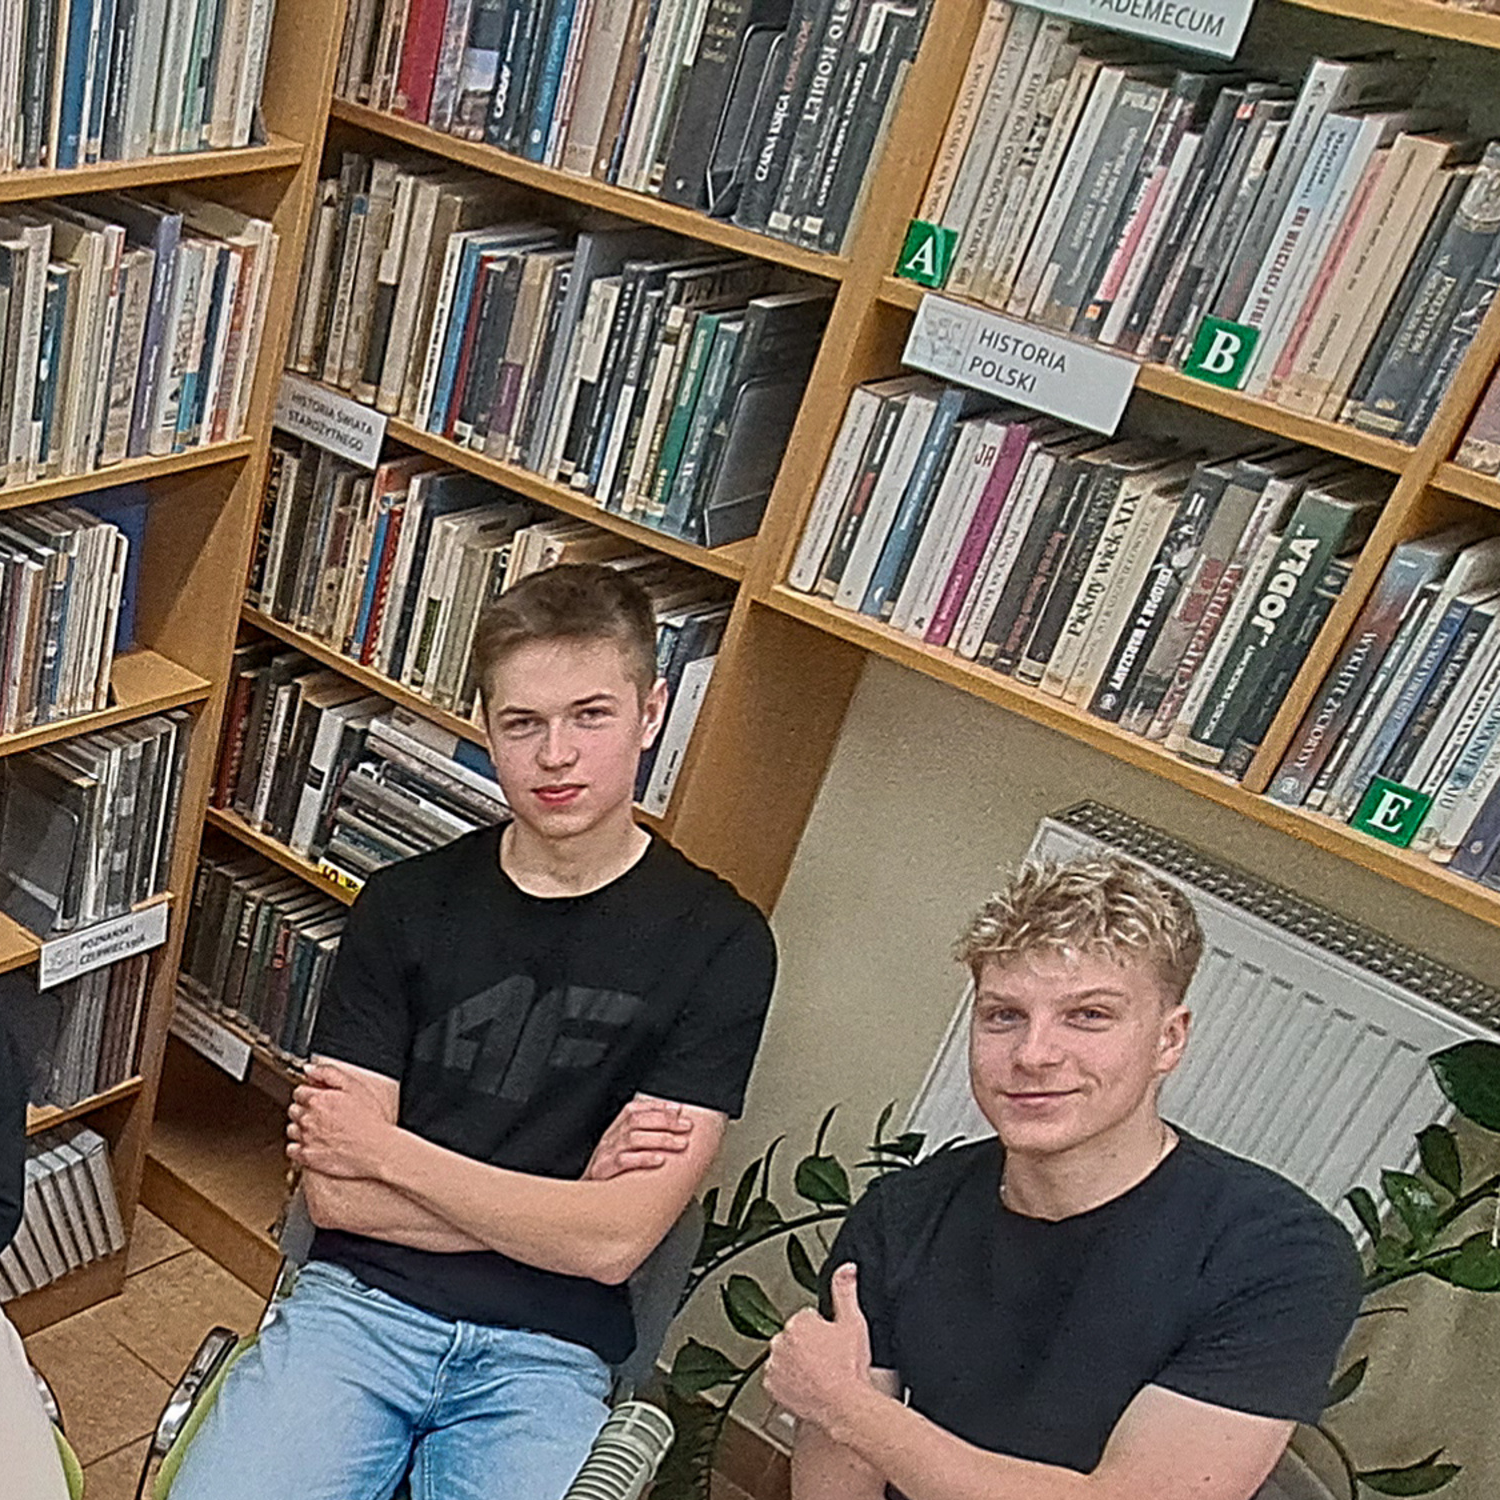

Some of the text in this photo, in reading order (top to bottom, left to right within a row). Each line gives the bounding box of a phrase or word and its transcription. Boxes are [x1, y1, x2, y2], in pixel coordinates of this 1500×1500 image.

[1088, 0, 1225, 37] ADEMECUM
[905, 242, 935, 276] A
[978, 328, 1067, 374] HISTORIA
[1202, 323, 1241, 374] B
[968, 356, 1037, 394] POLSKI
[1063, 489, 1142, 639] Piękny wiek XIX
[1365, 790, 1413, 833] E
